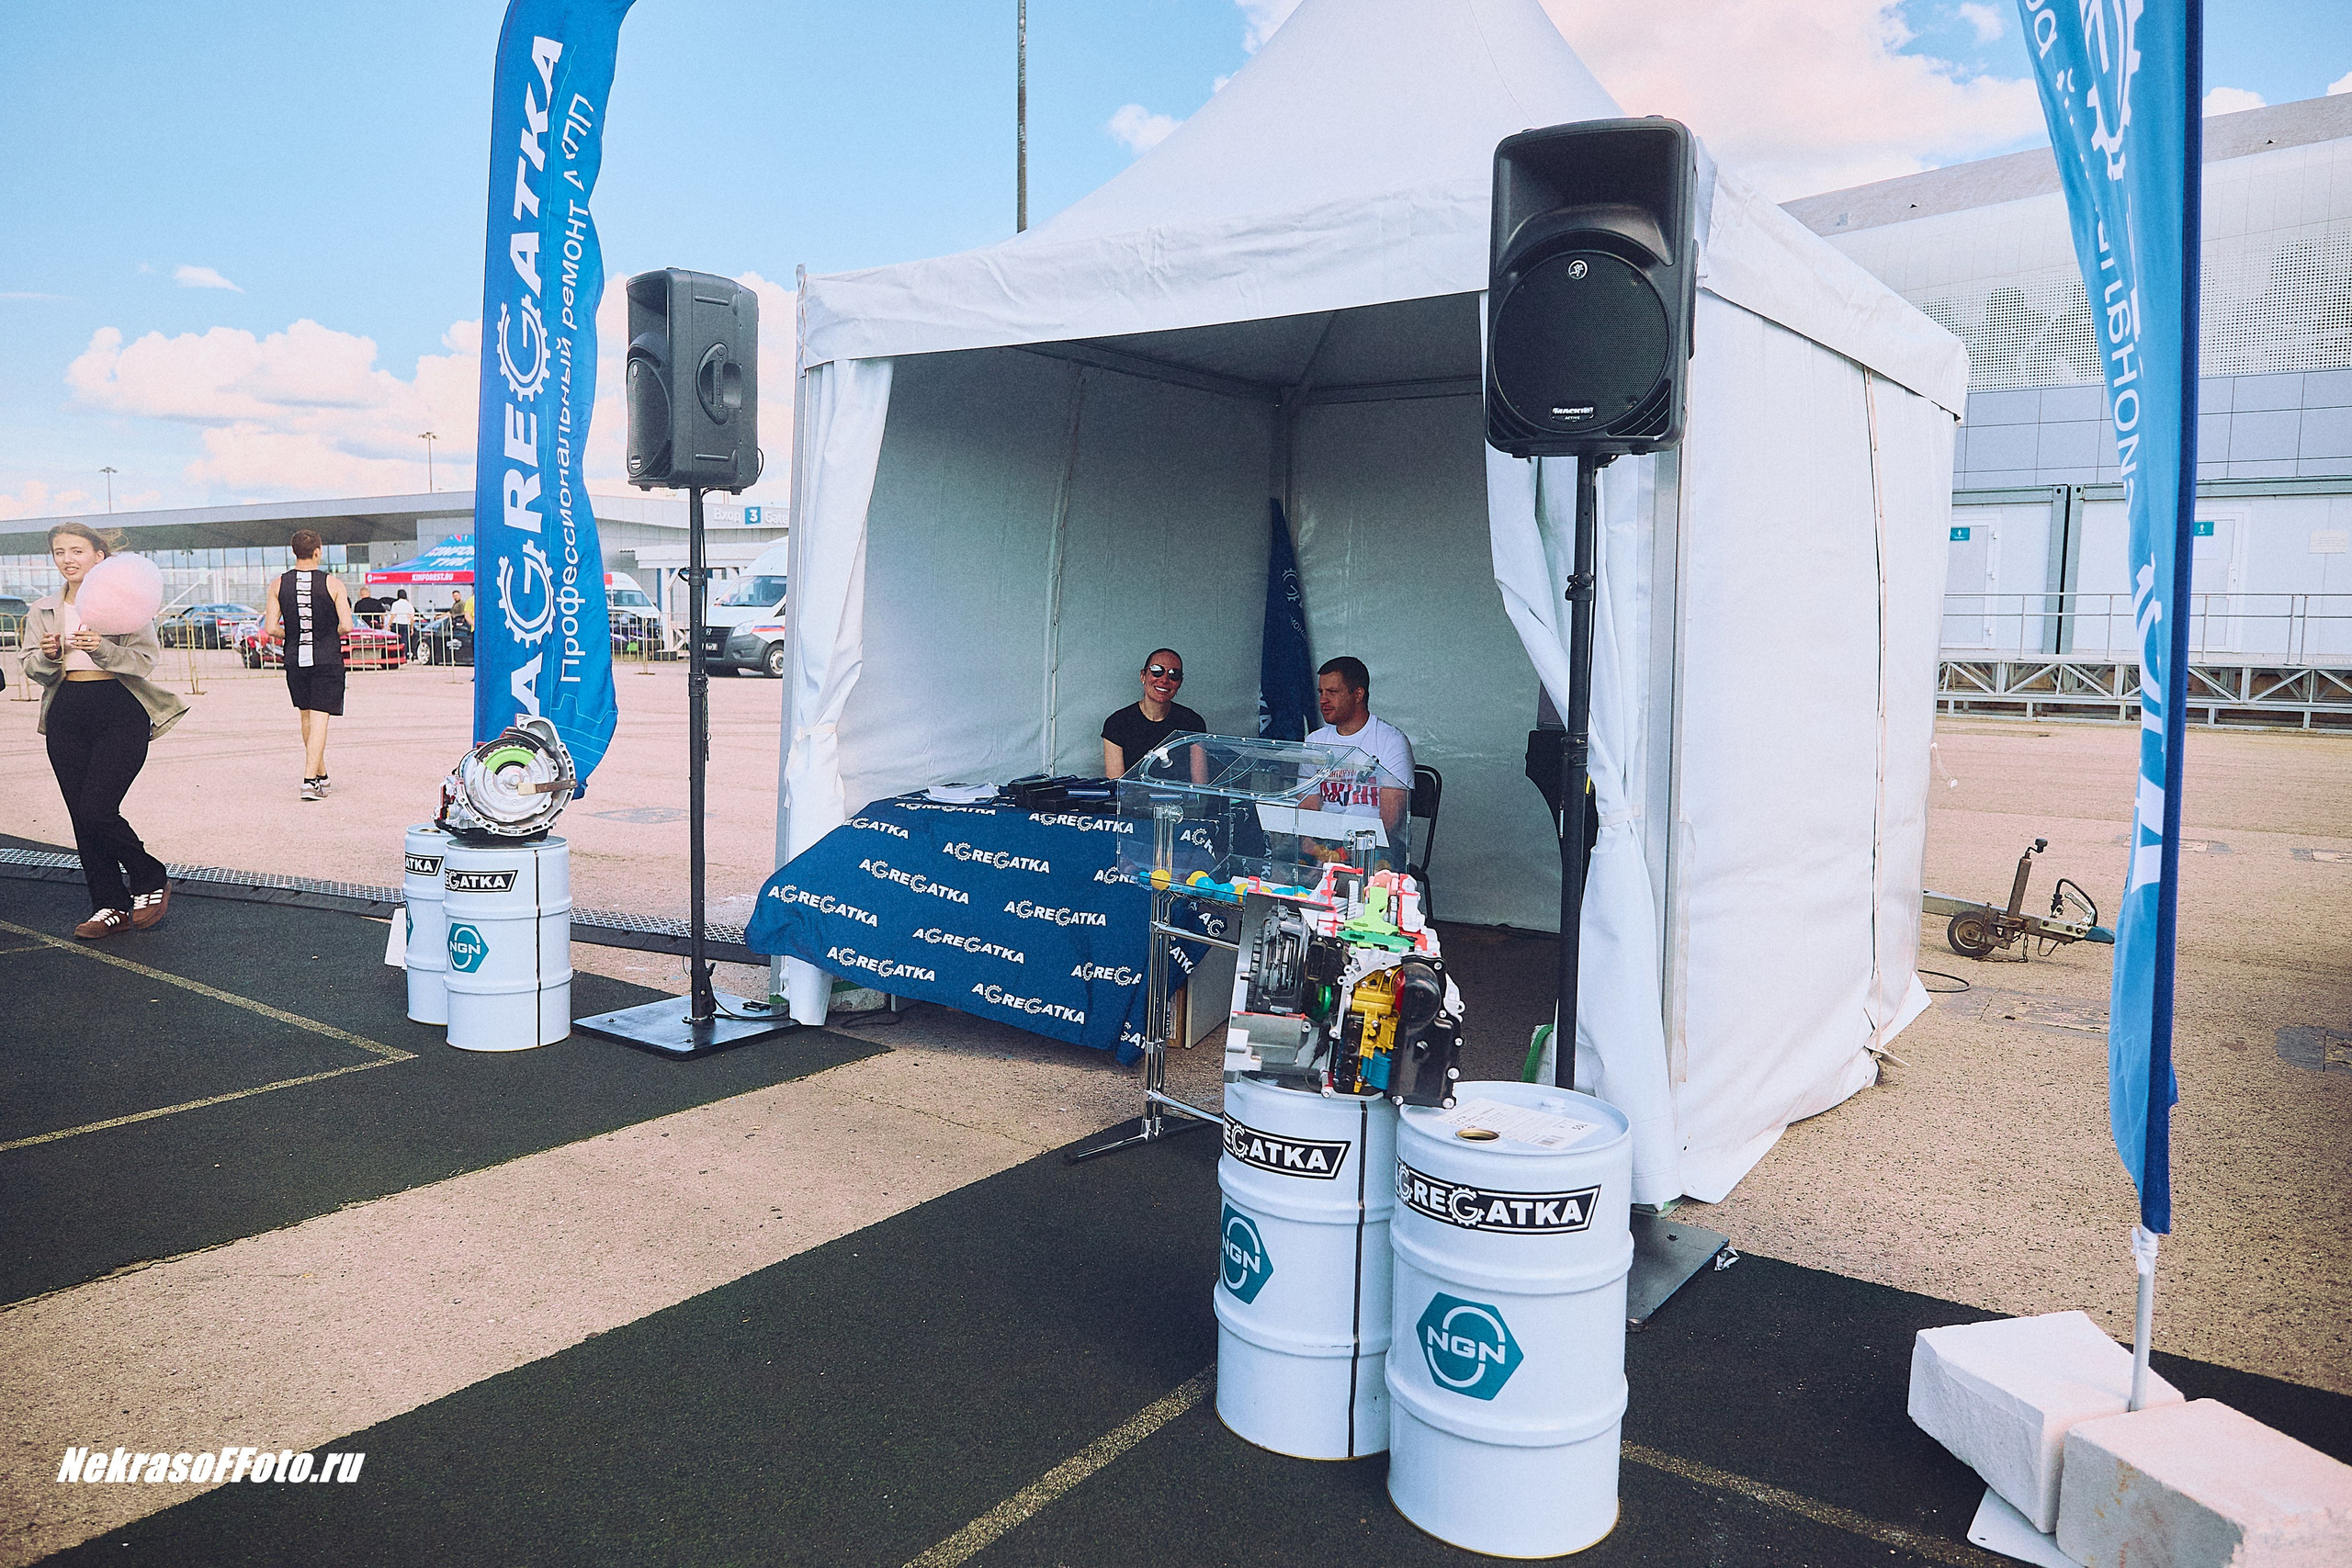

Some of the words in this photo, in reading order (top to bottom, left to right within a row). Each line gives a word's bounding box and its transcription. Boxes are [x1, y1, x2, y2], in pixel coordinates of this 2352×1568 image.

[560, 198, 589, 331] ремонт
[497, 36, 563, 716] AGREGATKA
[555, 336, 586, 682] Профессиональный
[714, 508, 741, 524] Вход
[749, 509, 758, 524] 3
[764, 511, 788, 525] Gate
[412, 573, 454, 581] KINFOREST.RU
[1028, 813, 1134, 834] AGREGATKA
[943, 841, 1050, 874] AGREGATKA
[859, 857, 969, 905] AGREGATKA
[768, 885, 878, 927] AGREGATKA
[1003, 899, 1106, 927] AGREGATKA
[449, 941, 481, 955] NGN
[827, 946, 935, 982] AGREGATKA
[912, 927, 1024, 964] AGREGATKA
[971, 982, 1086, 1025] AGREGATKA
[1224, 1121, 1329, 1170] EGATKA
[1396, 1163, 1583, 1226] GREGATKA
[1222, 1233, 1261, 1274] NGN
[1427, 1325, 1506, 1364] NGN
